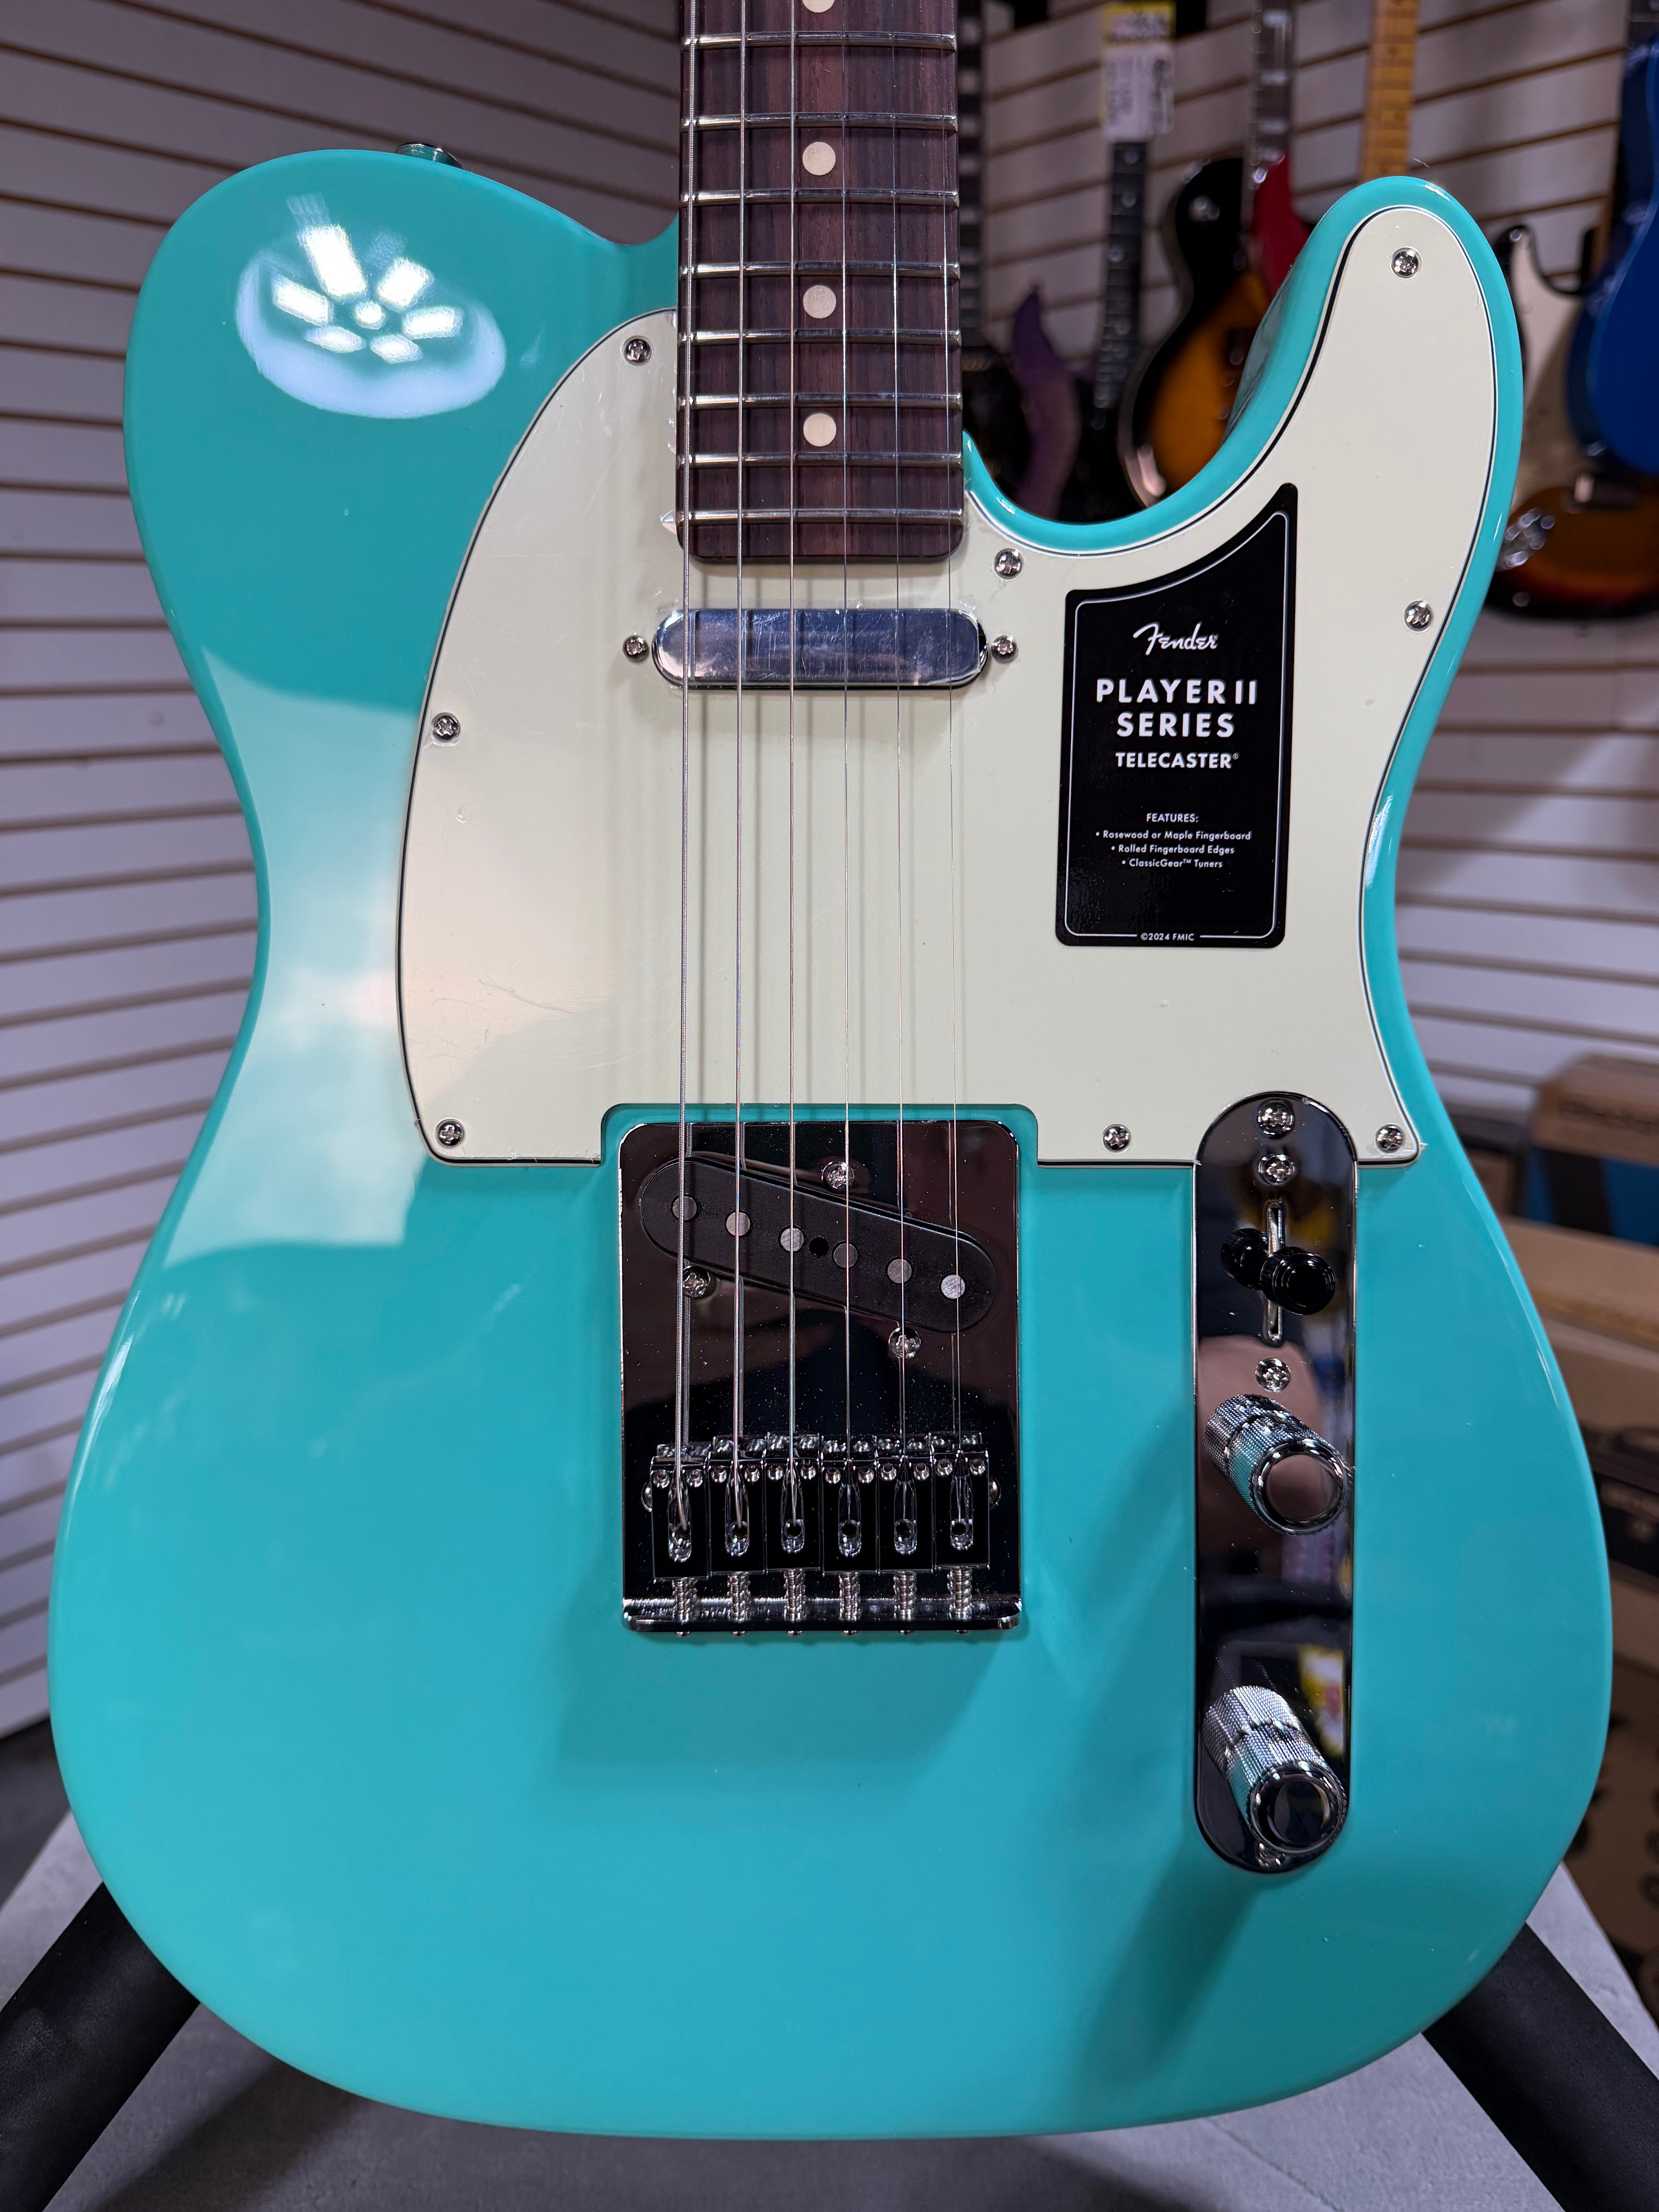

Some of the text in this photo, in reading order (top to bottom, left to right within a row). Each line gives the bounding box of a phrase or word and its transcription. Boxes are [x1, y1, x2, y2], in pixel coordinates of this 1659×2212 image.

[1096, 678, 1257, 704] PLAYER II
[1116, 712, 1234, 738] SERIES
[1146, 813, 1199, 823] FEATURES:
[1103, 830, 1149, 839] Rosewood
[1164, 830, 1193, 841] Maple
[1196, 831, 1252, 842] Fingerboard
[1118, 844, 1235, 856] Rolled Fingerboard Edges
[1194, 859, 1223, 868] Tuners
[1140, 933, 1170, 941] ©2024
